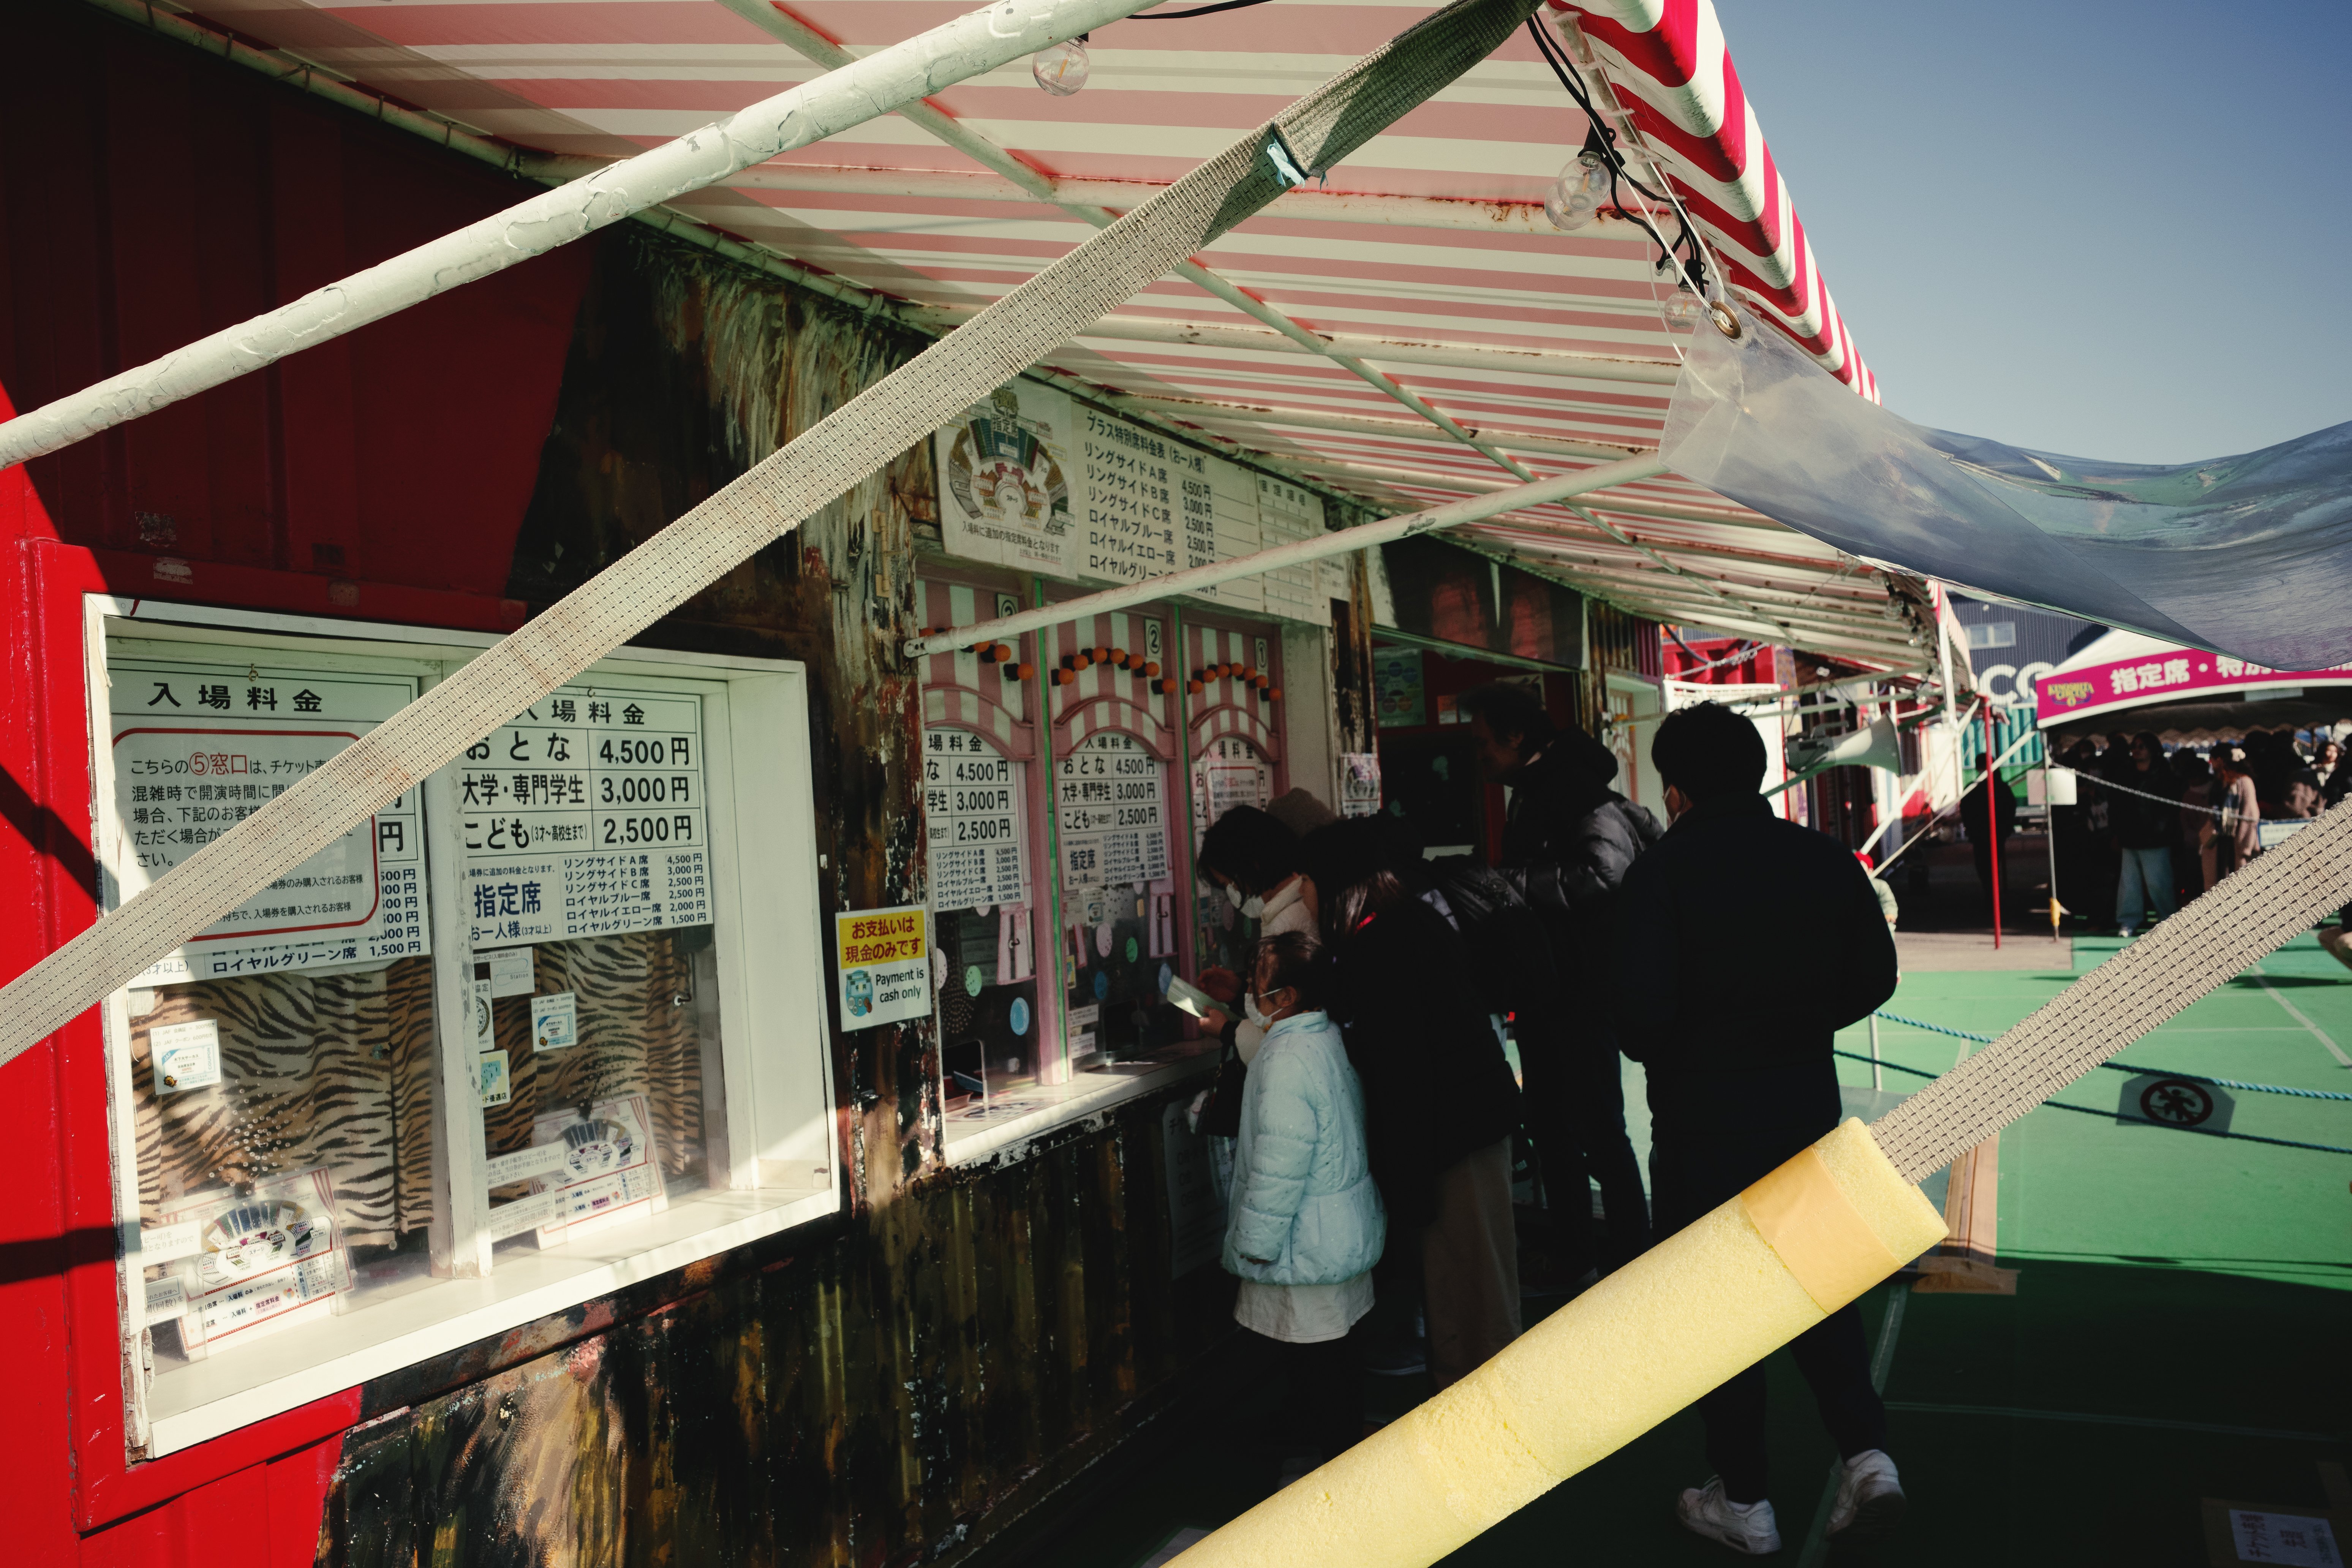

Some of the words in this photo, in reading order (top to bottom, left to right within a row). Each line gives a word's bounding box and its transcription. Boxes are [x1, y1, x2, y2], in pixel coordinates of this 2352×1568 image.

[148, 682, 322, 712] 入場料金
[466, 731, 570, 761] おとな
[600, 737, 689, 765] 4,500円
[928, 734, 982, 752] 場料金
[926, 759, 939, 780] な
[956, 760, 1008, 782] 4,500円
[1064, 756, 1105, 774] おとな
[1116, 756, 1155, 775] 4,500円
[132, 784, 291, 802] 混雑時で開演時間に間
[462, 773, 585, 806] 大学・専門学生
[601, 777, 689, 805] 3,000円
[1062, 782, 1111, 802] 大学・専門学生
[1117, 782, 1155, 801] 3,000円
[928, 789, 948, 812] 学生
[957, 790, 1008, 811] 3,000円
[1118, 807, 1157, 825] 2,500円
[603, 815, 691, 845] 2,500円
[958, 819, 1010, 841] 2,500円
[136, 853, 173, 867] さい。
[564, 855, 648, 869] リングサイドA席
[667, 853, 702, 865] 4,500円
[936, 849, 985, 860] リングサイドA席
[996, 847, 1017, 855] 4,500円
[937, 858, 985, 869] リングサイドB席
[996, 855, 1018, 864] 3,000円
[1070, 848, 1095, 871] 指定席
[565, 867, 649, 881] リングサイドB席
[667, 865, 703, 876] 3,000円
[937, 866, 985, 878] リングサイドC席
[996, 864, 1018, 873] 2,500円
[937, 876, 986, 887] ロイヤルブルー席
[997, 873, 1019, 882] 2,500円
[267, 874, 363, 889] 場券のみ購入されるお客様
[566, 879, 650, 894] リングサイドC席
[668, 876, 703, 887] 2,500円
[938, 885, 993, 898] ロイヤルイエロー席
[998, 882, 1020, 891] 2,000円
[474, 880, 541, 918] 指定席
[566, 891, 651, 906] ロイヤルブルー席
[669, 888, 704, 899] 2,500円
[938, 895, 993, 908] ロイヤルグリーン席
[999, 892, 1021, 901] 1,500円
[567, 903, 661, 920] ロイヤルイエロー席
[670, 900, 705, 912] 2,000円
[568, 916, 662, 934] ロイヤルグリーン席
[671, 912, 707, 924] 1,500円
[852, 916, 915, 939] お支払いは
[213, 947, 357, 973] ロイヤルグリーン席
[369, 941, 421, 957] 1,500円
[845, 937, 921, 963] 現金のみです
[875, 969, 914, 987] Payment
[916, 967, 924, 979] is
[880, 989, 899, 1003] cash
[902, 985, 921, 999] only
[256, 1296, 280, 1309] 指定席料金
